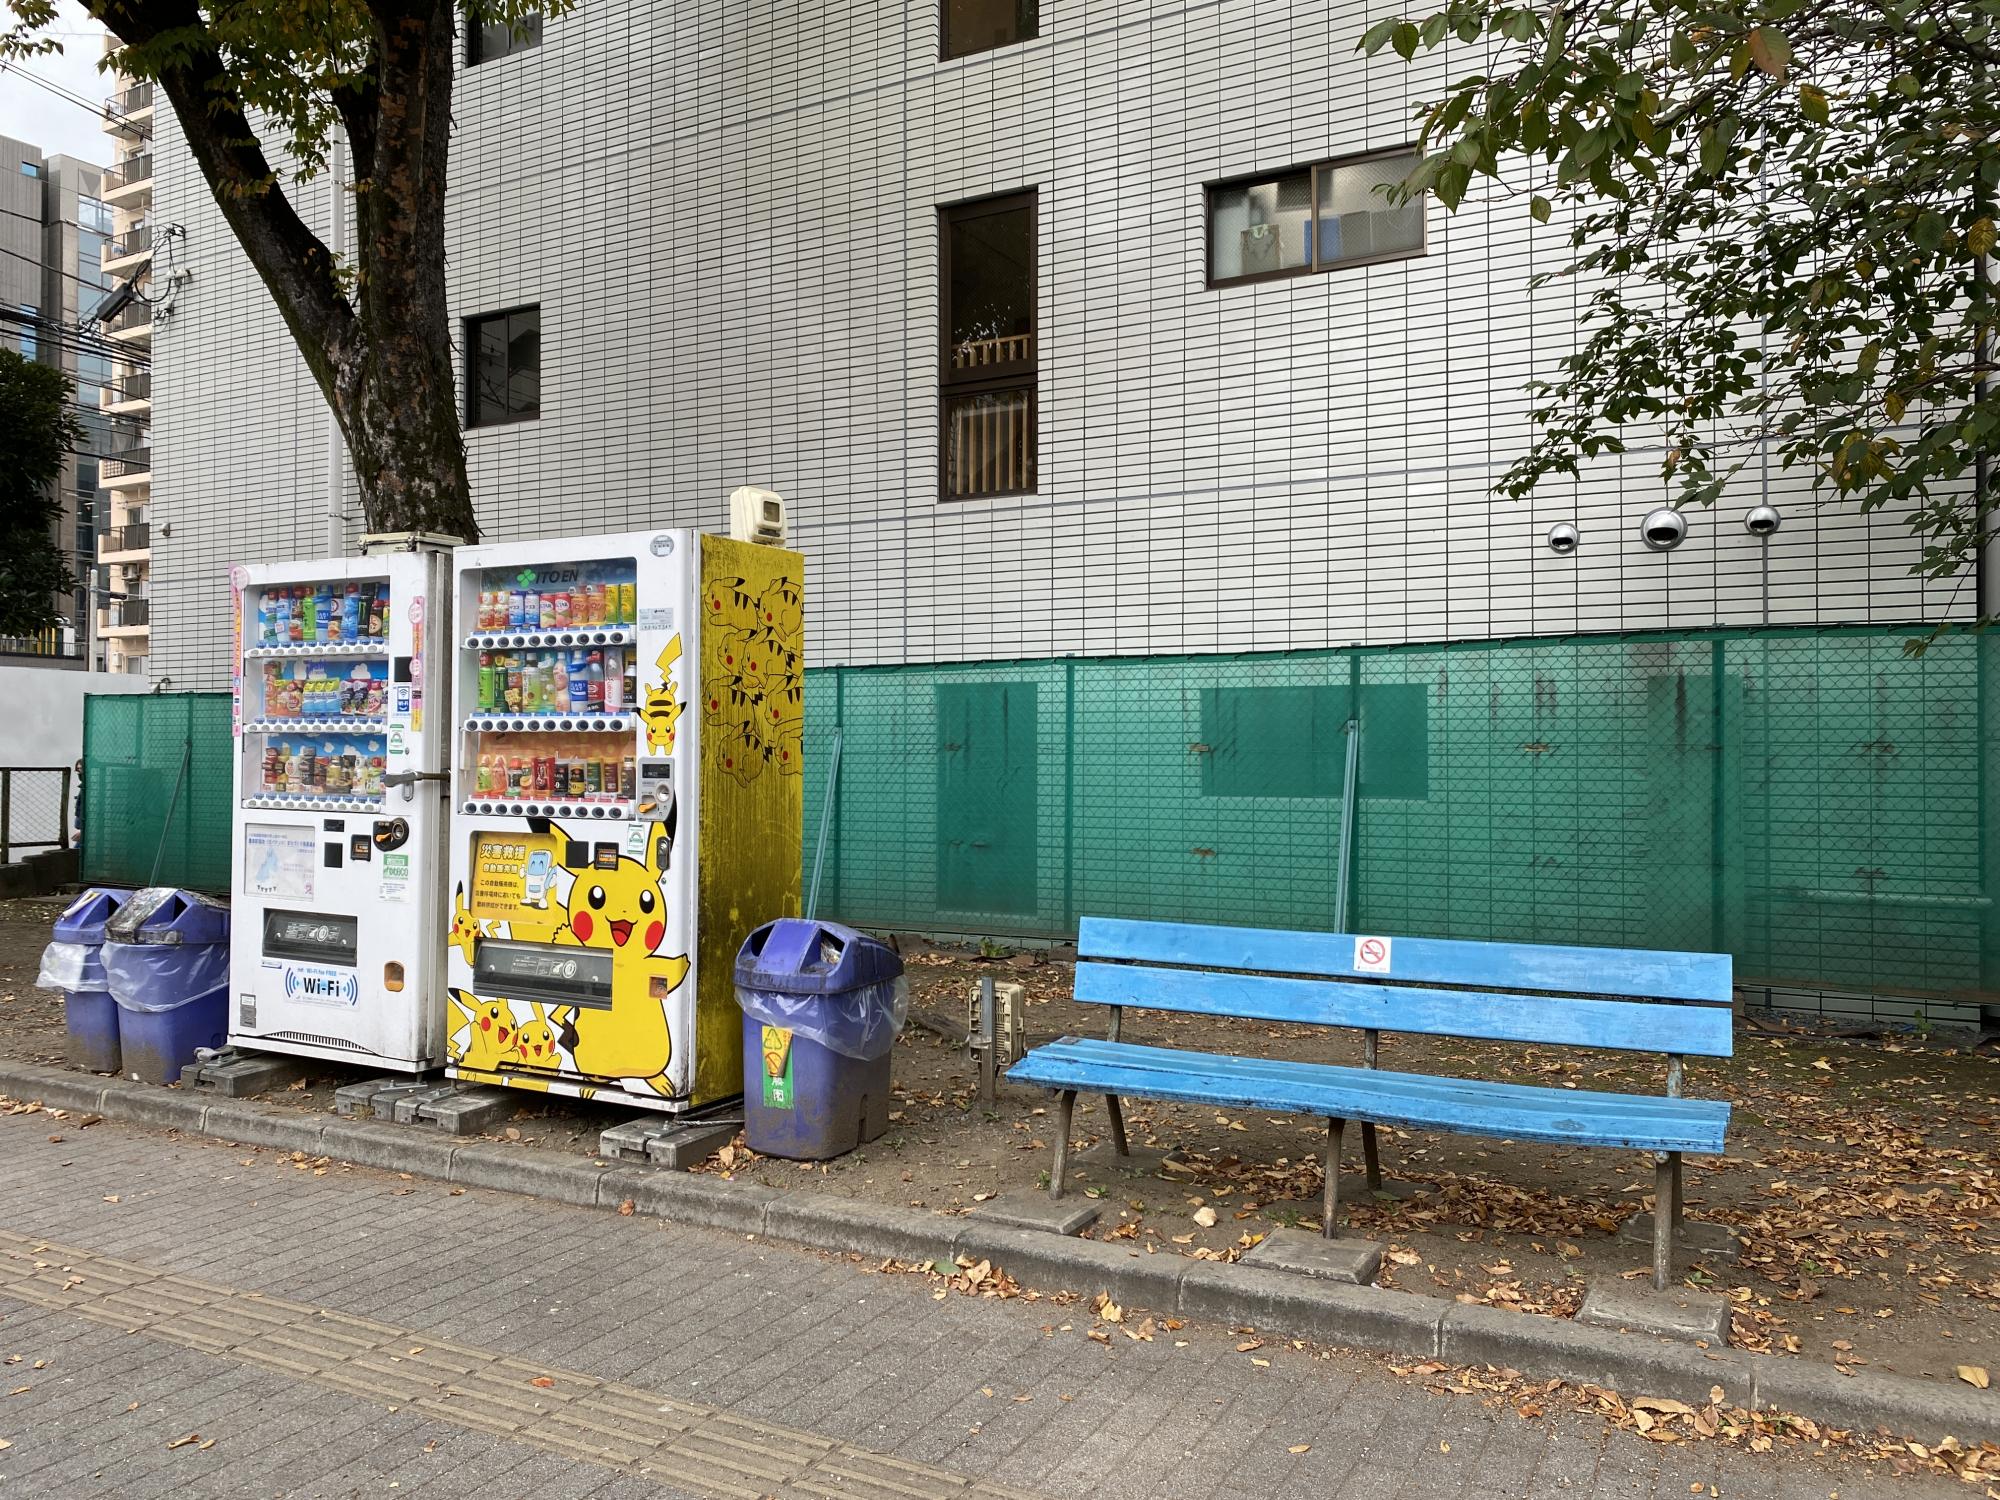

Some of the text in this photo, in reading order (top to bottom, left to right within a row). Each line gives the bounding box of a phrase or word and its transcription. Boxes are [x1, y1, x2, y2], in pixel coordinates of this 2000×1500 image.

[536, 569, 579, 584] ITO EN
[480, 844, 525, 860] 災害救援
[303, 977, 340, 997] Wi-Fi
